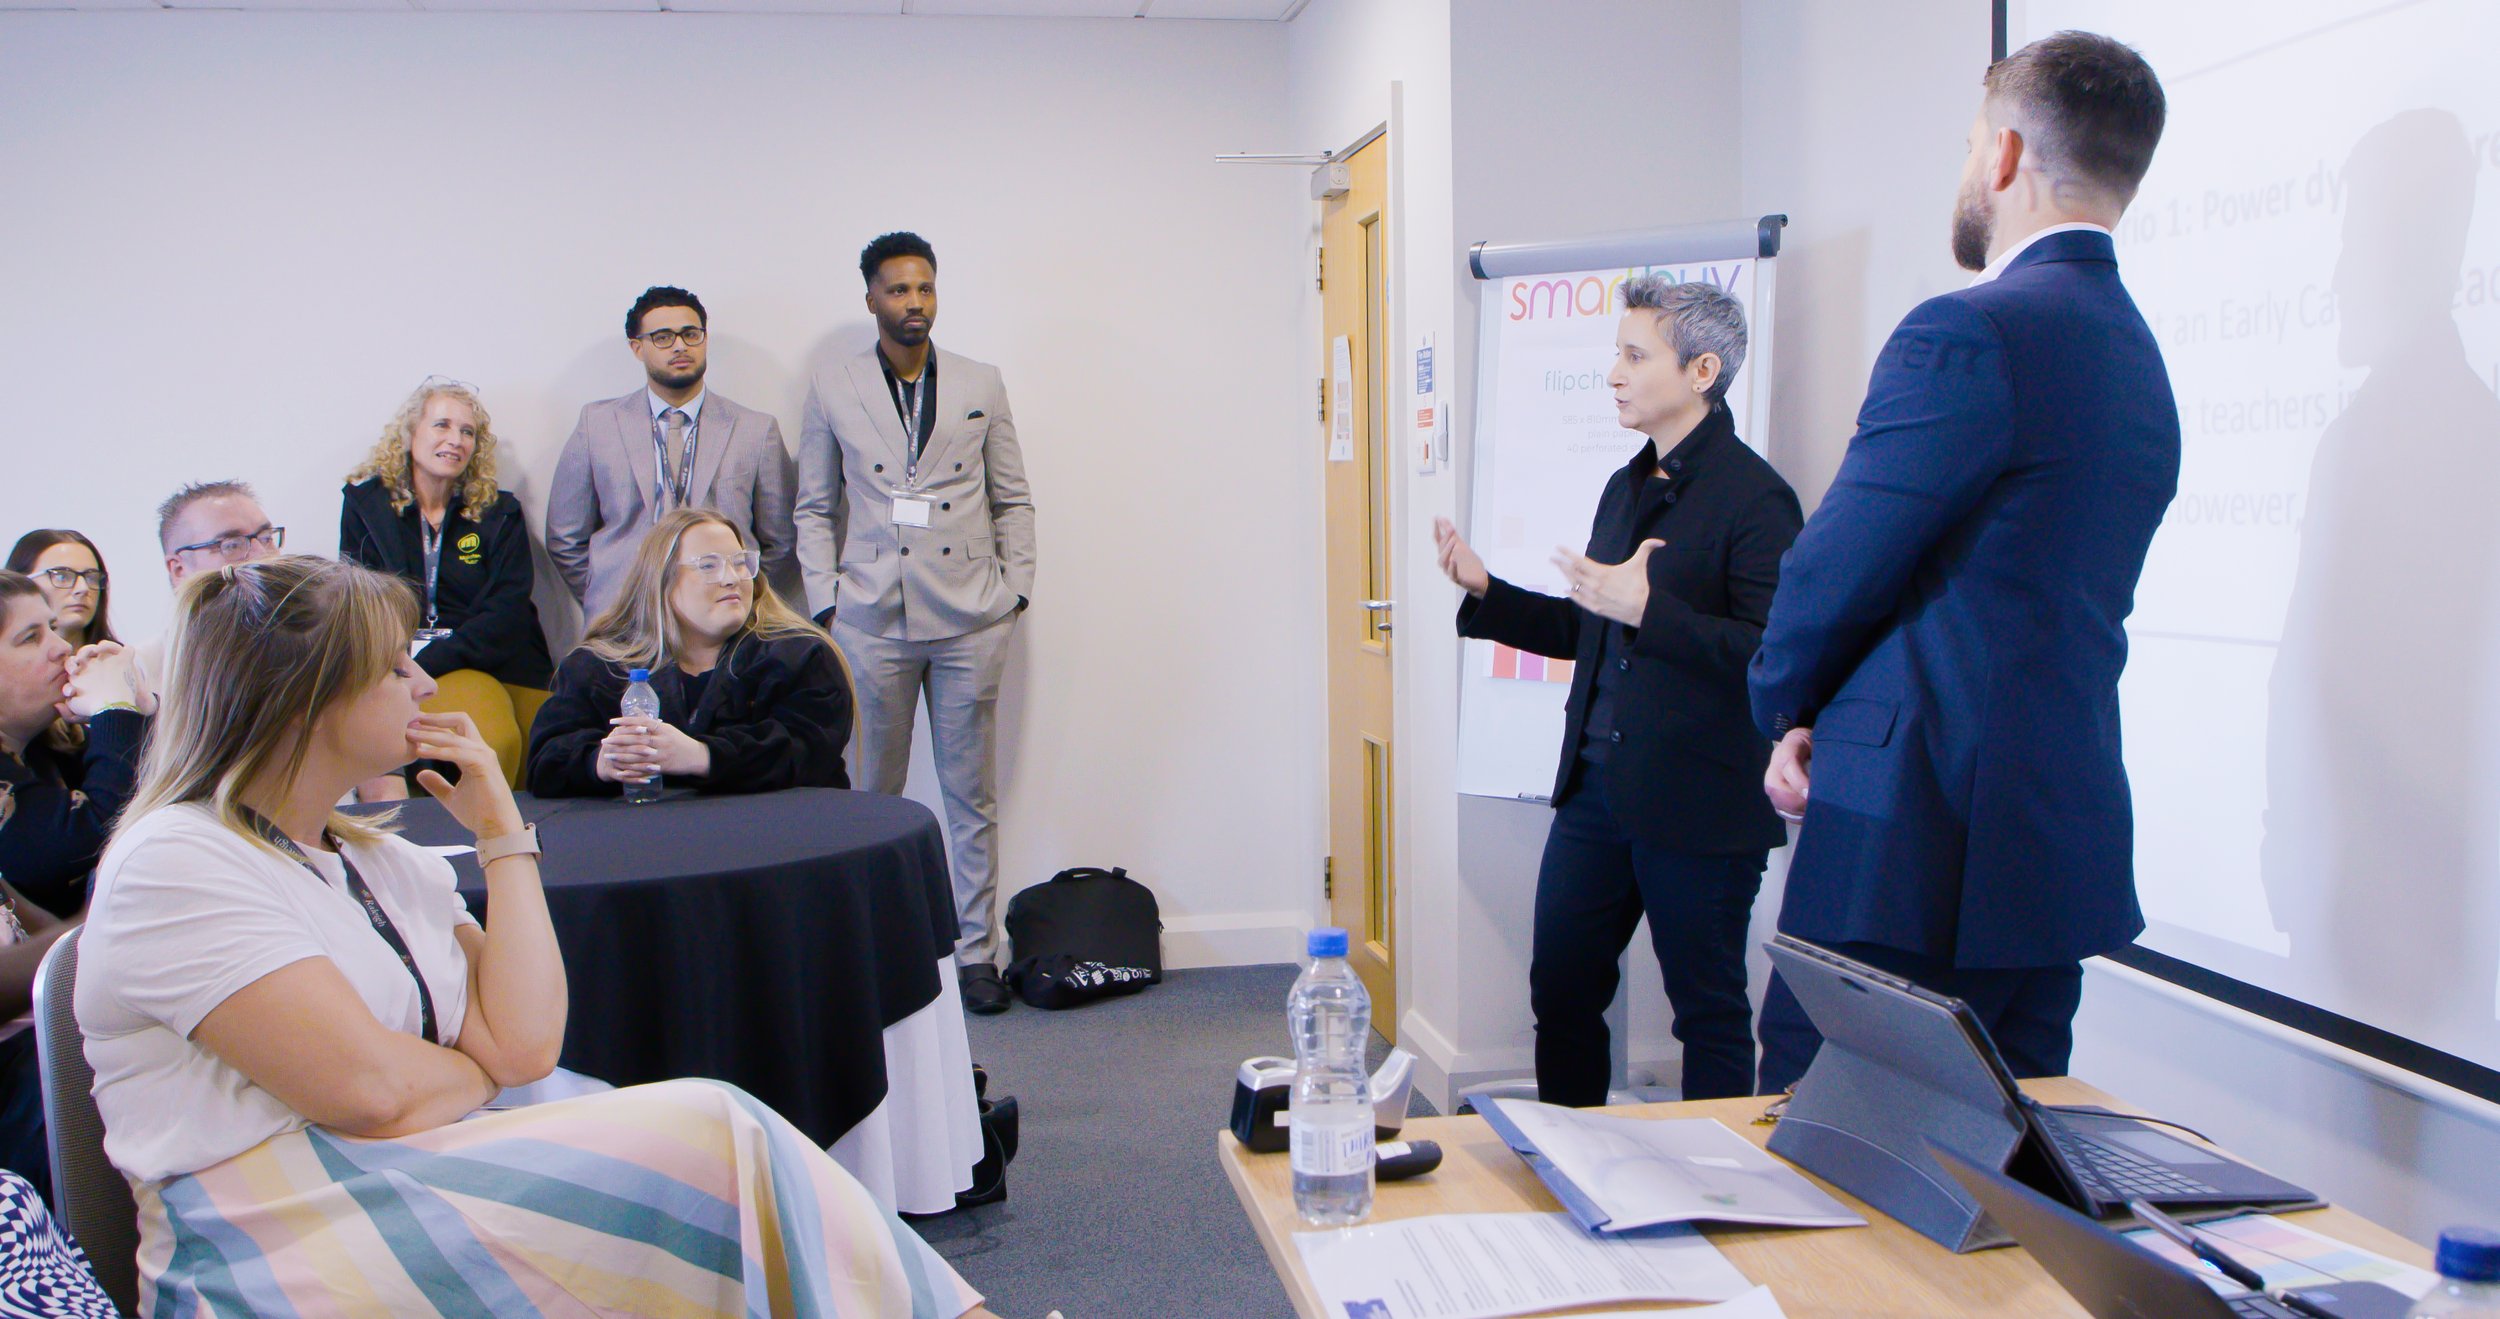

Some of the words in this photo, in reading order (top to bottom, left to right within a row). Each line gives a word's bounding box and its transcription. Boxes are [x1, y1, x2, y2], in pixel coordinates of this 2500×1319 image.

[2167, 198, 2192, 237] 1:
[2203, 178, 2297, 231] Power
[2305, 159, 2346, 215] dy
[2174, 312, 2208, 346] an
[2219, 289, 2290, 345] Early
[2298, 283, 2336, 329] Ca
[1544, 368, 1604, 397] flipch
[2200, 385, 2328, 435] teachers
